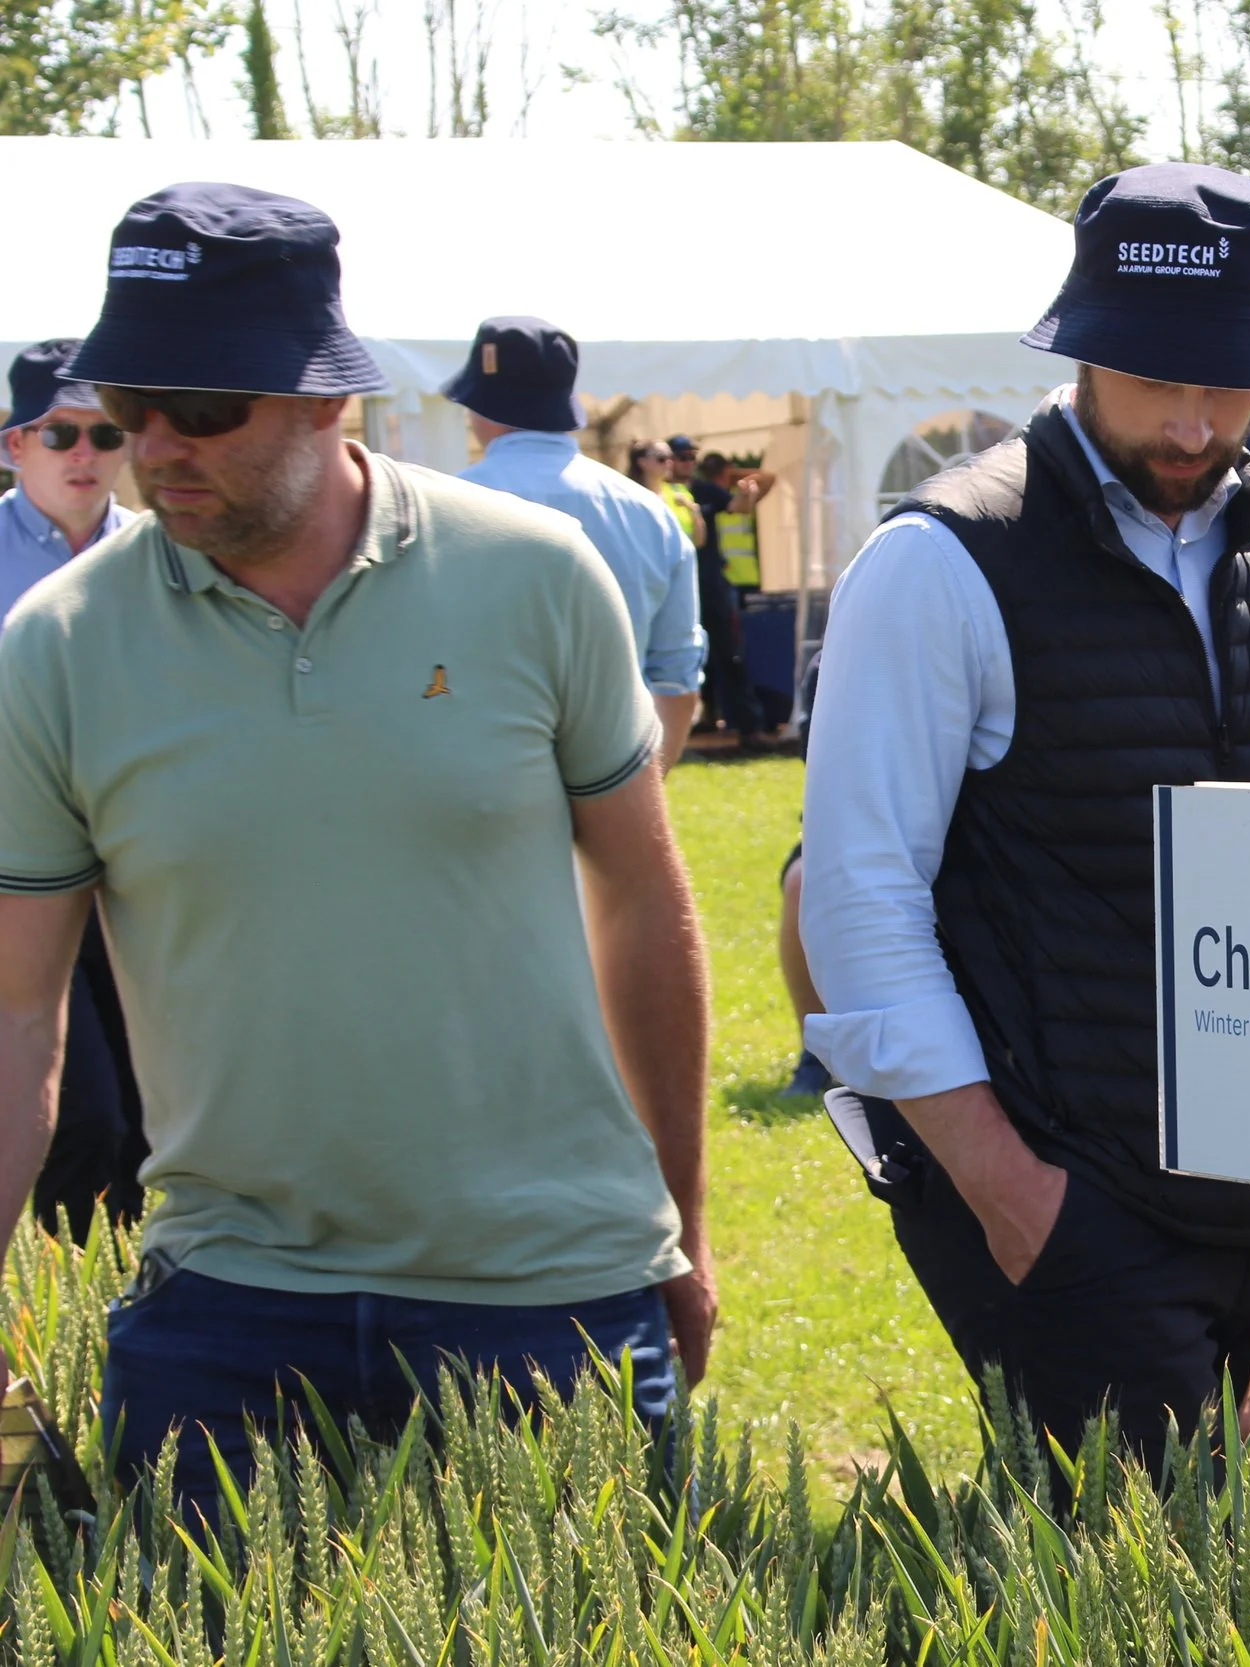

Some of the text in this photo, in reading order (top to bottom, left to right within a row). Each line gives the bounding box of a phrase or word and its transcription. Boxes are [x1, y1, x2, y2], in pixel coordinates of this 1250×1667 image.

[1118, 242, 1214, 265] SEEDTECH
[1155, 266, 1181, 275] GROUP
[1182, 267, 1221, 277] COMPANY
[1194, 1009, 1249, 1037] Winter
